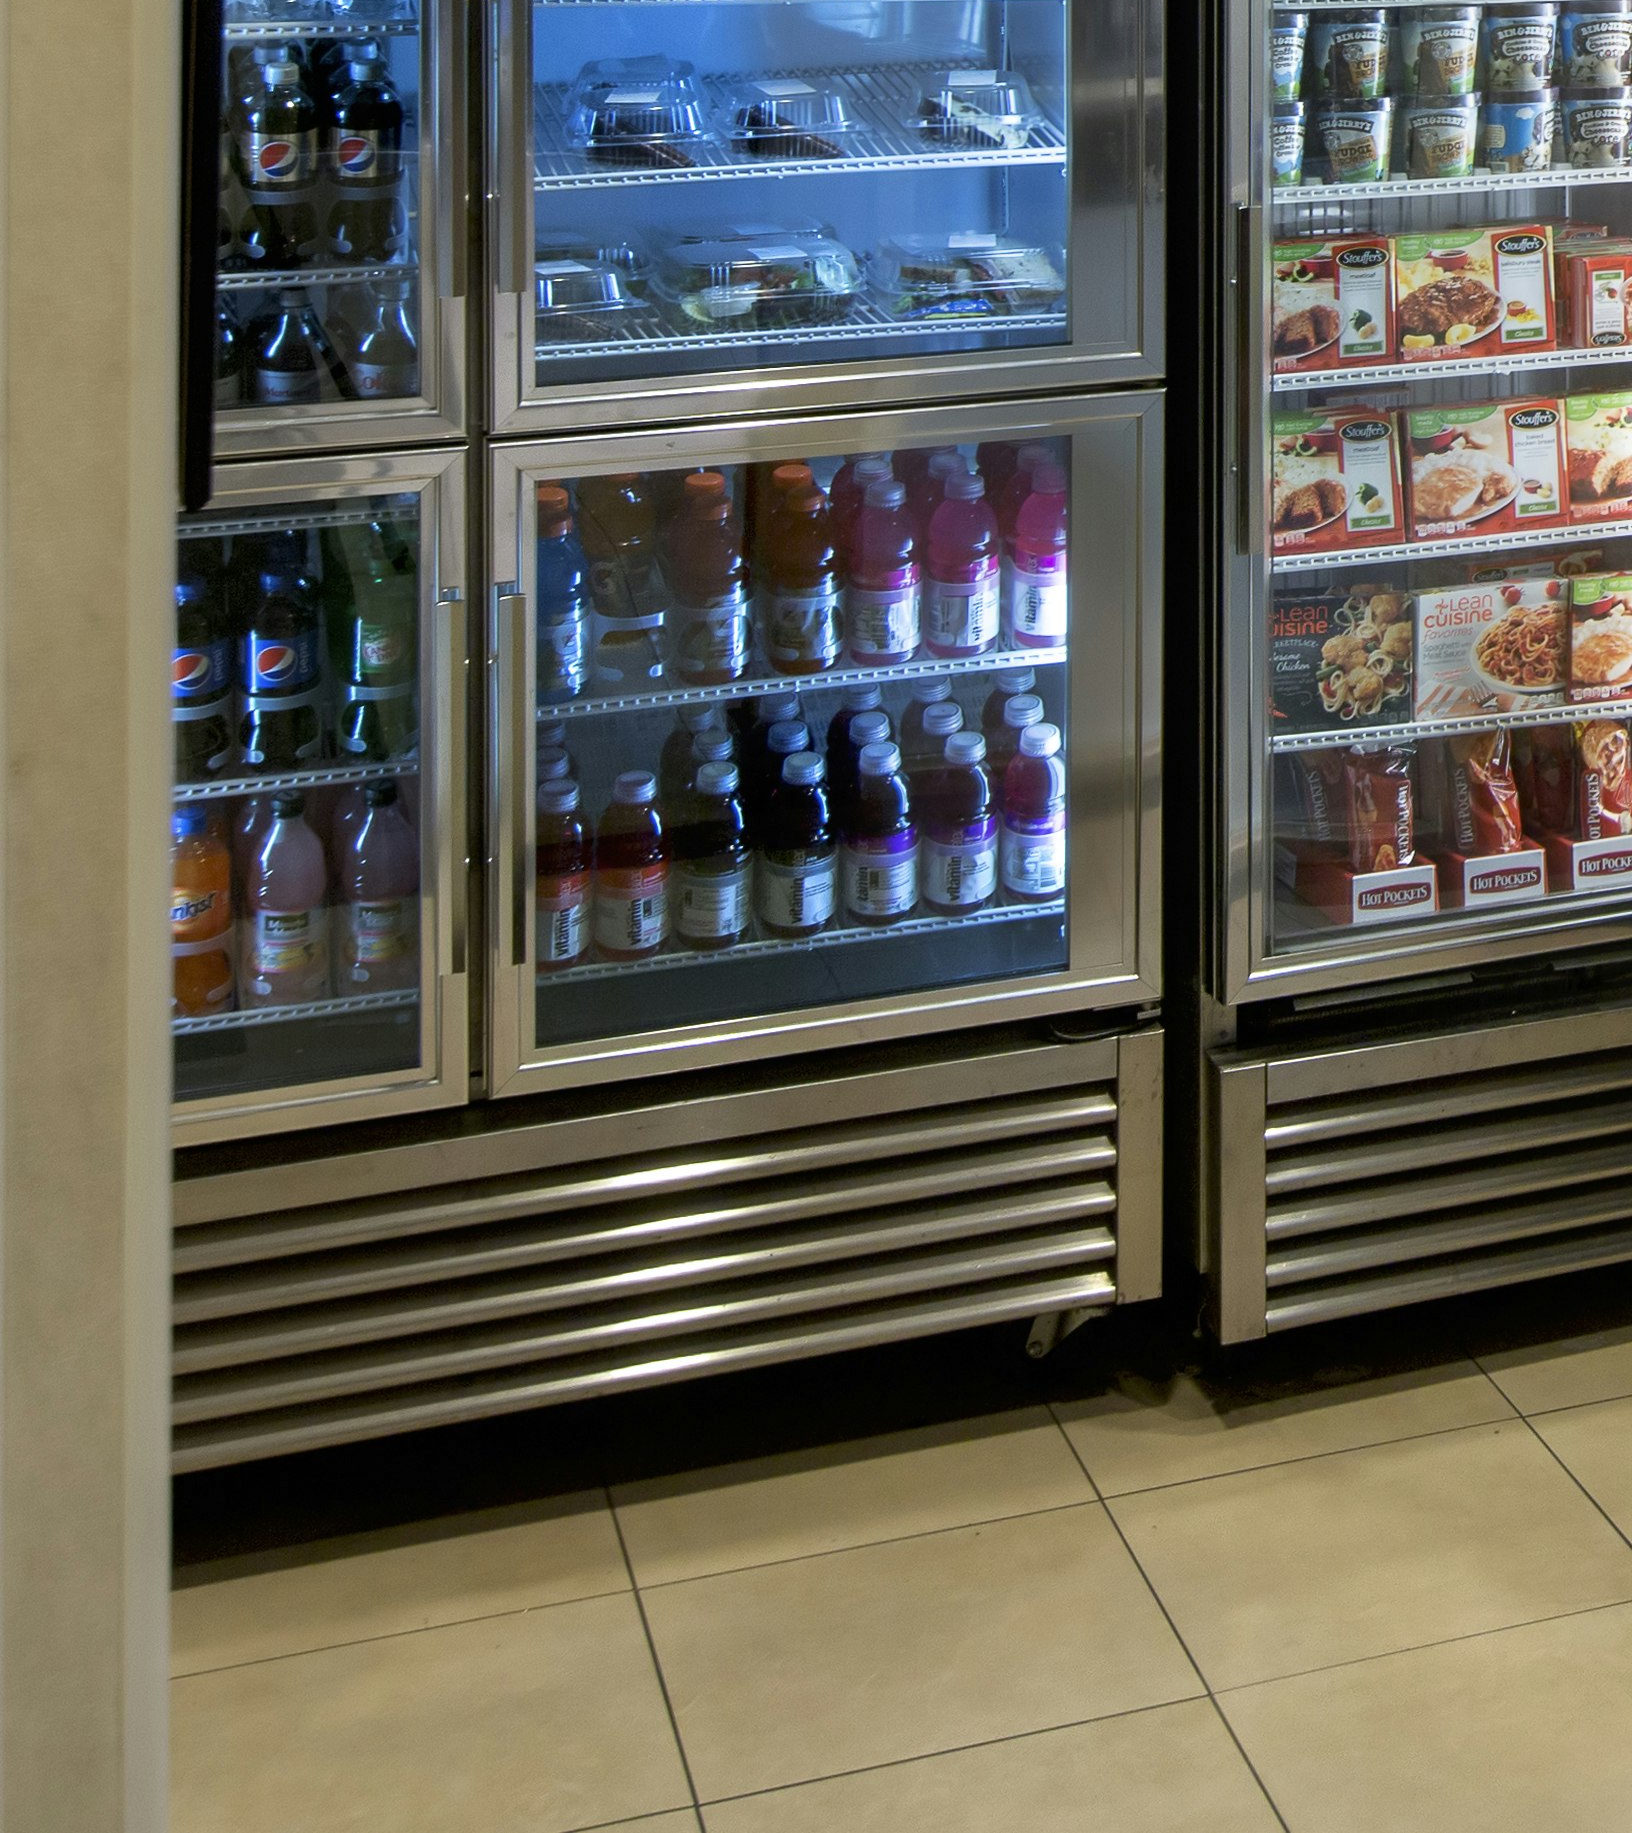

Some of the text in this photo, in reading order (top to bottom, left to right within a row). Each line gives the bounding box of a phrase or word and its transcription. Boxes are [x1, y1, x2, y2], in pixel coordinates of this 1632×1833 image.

[1337, 119, 1372, 131] JERRY'S
[1576, 111, 1594, 122] BEN
[1502, 238, 1540, 251] Stouffer's
[1343, 250, 1383, 264] Stouffer's
[1515, 411, 1553, 426] Stouffer's
[1345, 423, 1385, 438] Stouffer's
[1024, 586, 1038, 631] vitamin
[1450, 594, 1493, 612] Lean
[1281, 606, 1329, 623] Lean
[1424, 608, 1493, 628] cuisine
[1270, 620, 1328, 637] uisine
[1423, 649, 1466, 660] Meat Sauce
[1276, 661, 1310, 672] Chicken
[1455, 769, 1472, 819] POCKETS
[1587, 774, 1600, 821] POCKETS
[1582, 860, 1601, 873] HOT
[949, 855, 961, 901] vitamin
[1473, 870, 1537, 891] HOT POCKETS
[1361, 886, 1428, 907] HOT POCKETS
[560, 906, 570, 956] vitamin
